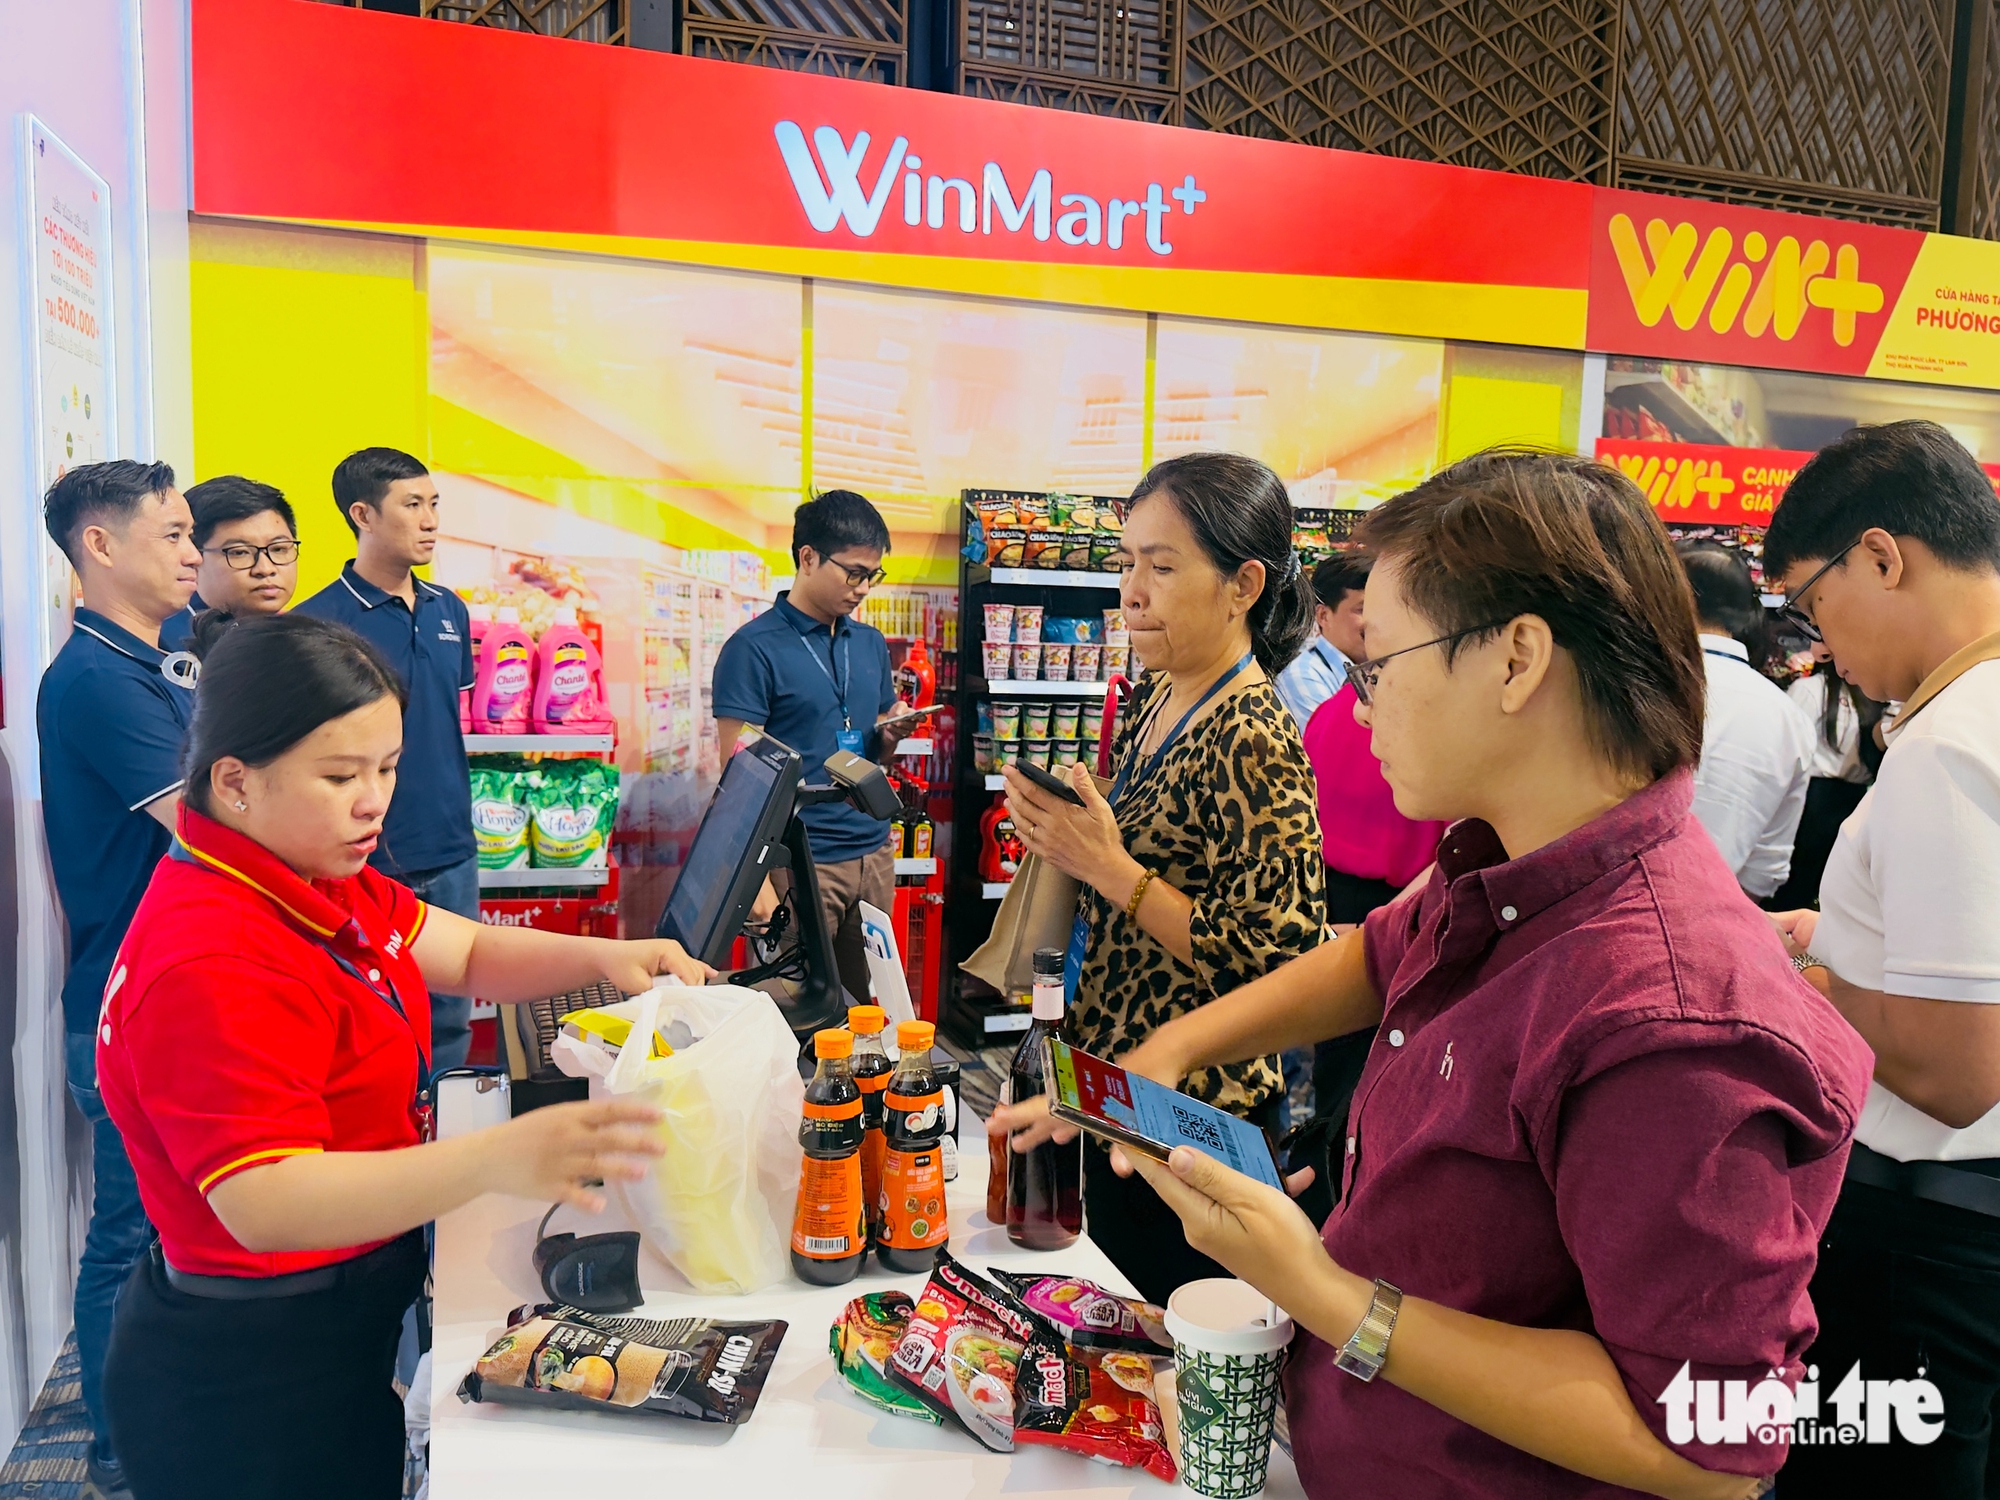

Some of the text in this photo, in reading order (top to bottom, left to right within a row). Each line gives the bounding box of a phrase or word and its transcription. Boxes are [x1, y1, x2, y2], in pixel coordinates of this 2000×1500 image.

[774, 120, 1207, 255] WinMart+
[44, 215, 58, 240] CÁC
[1935, 286, 1957, 301] CỬA
[1960, 290, 1990, 304] HÀNG
[1917, 307, 2000, 335] PHƯƠNG
[1741, 490, 1773, 512] GIÁ
[497, 673, 526, 686] Chanté
[555, 673, 586, 687] Chanté
[482, 905, 542, 926] Mart+
[706, 1335, 754, 1396] CHIN-SU
[1190, 1401, 1214, 1416] GIAO
